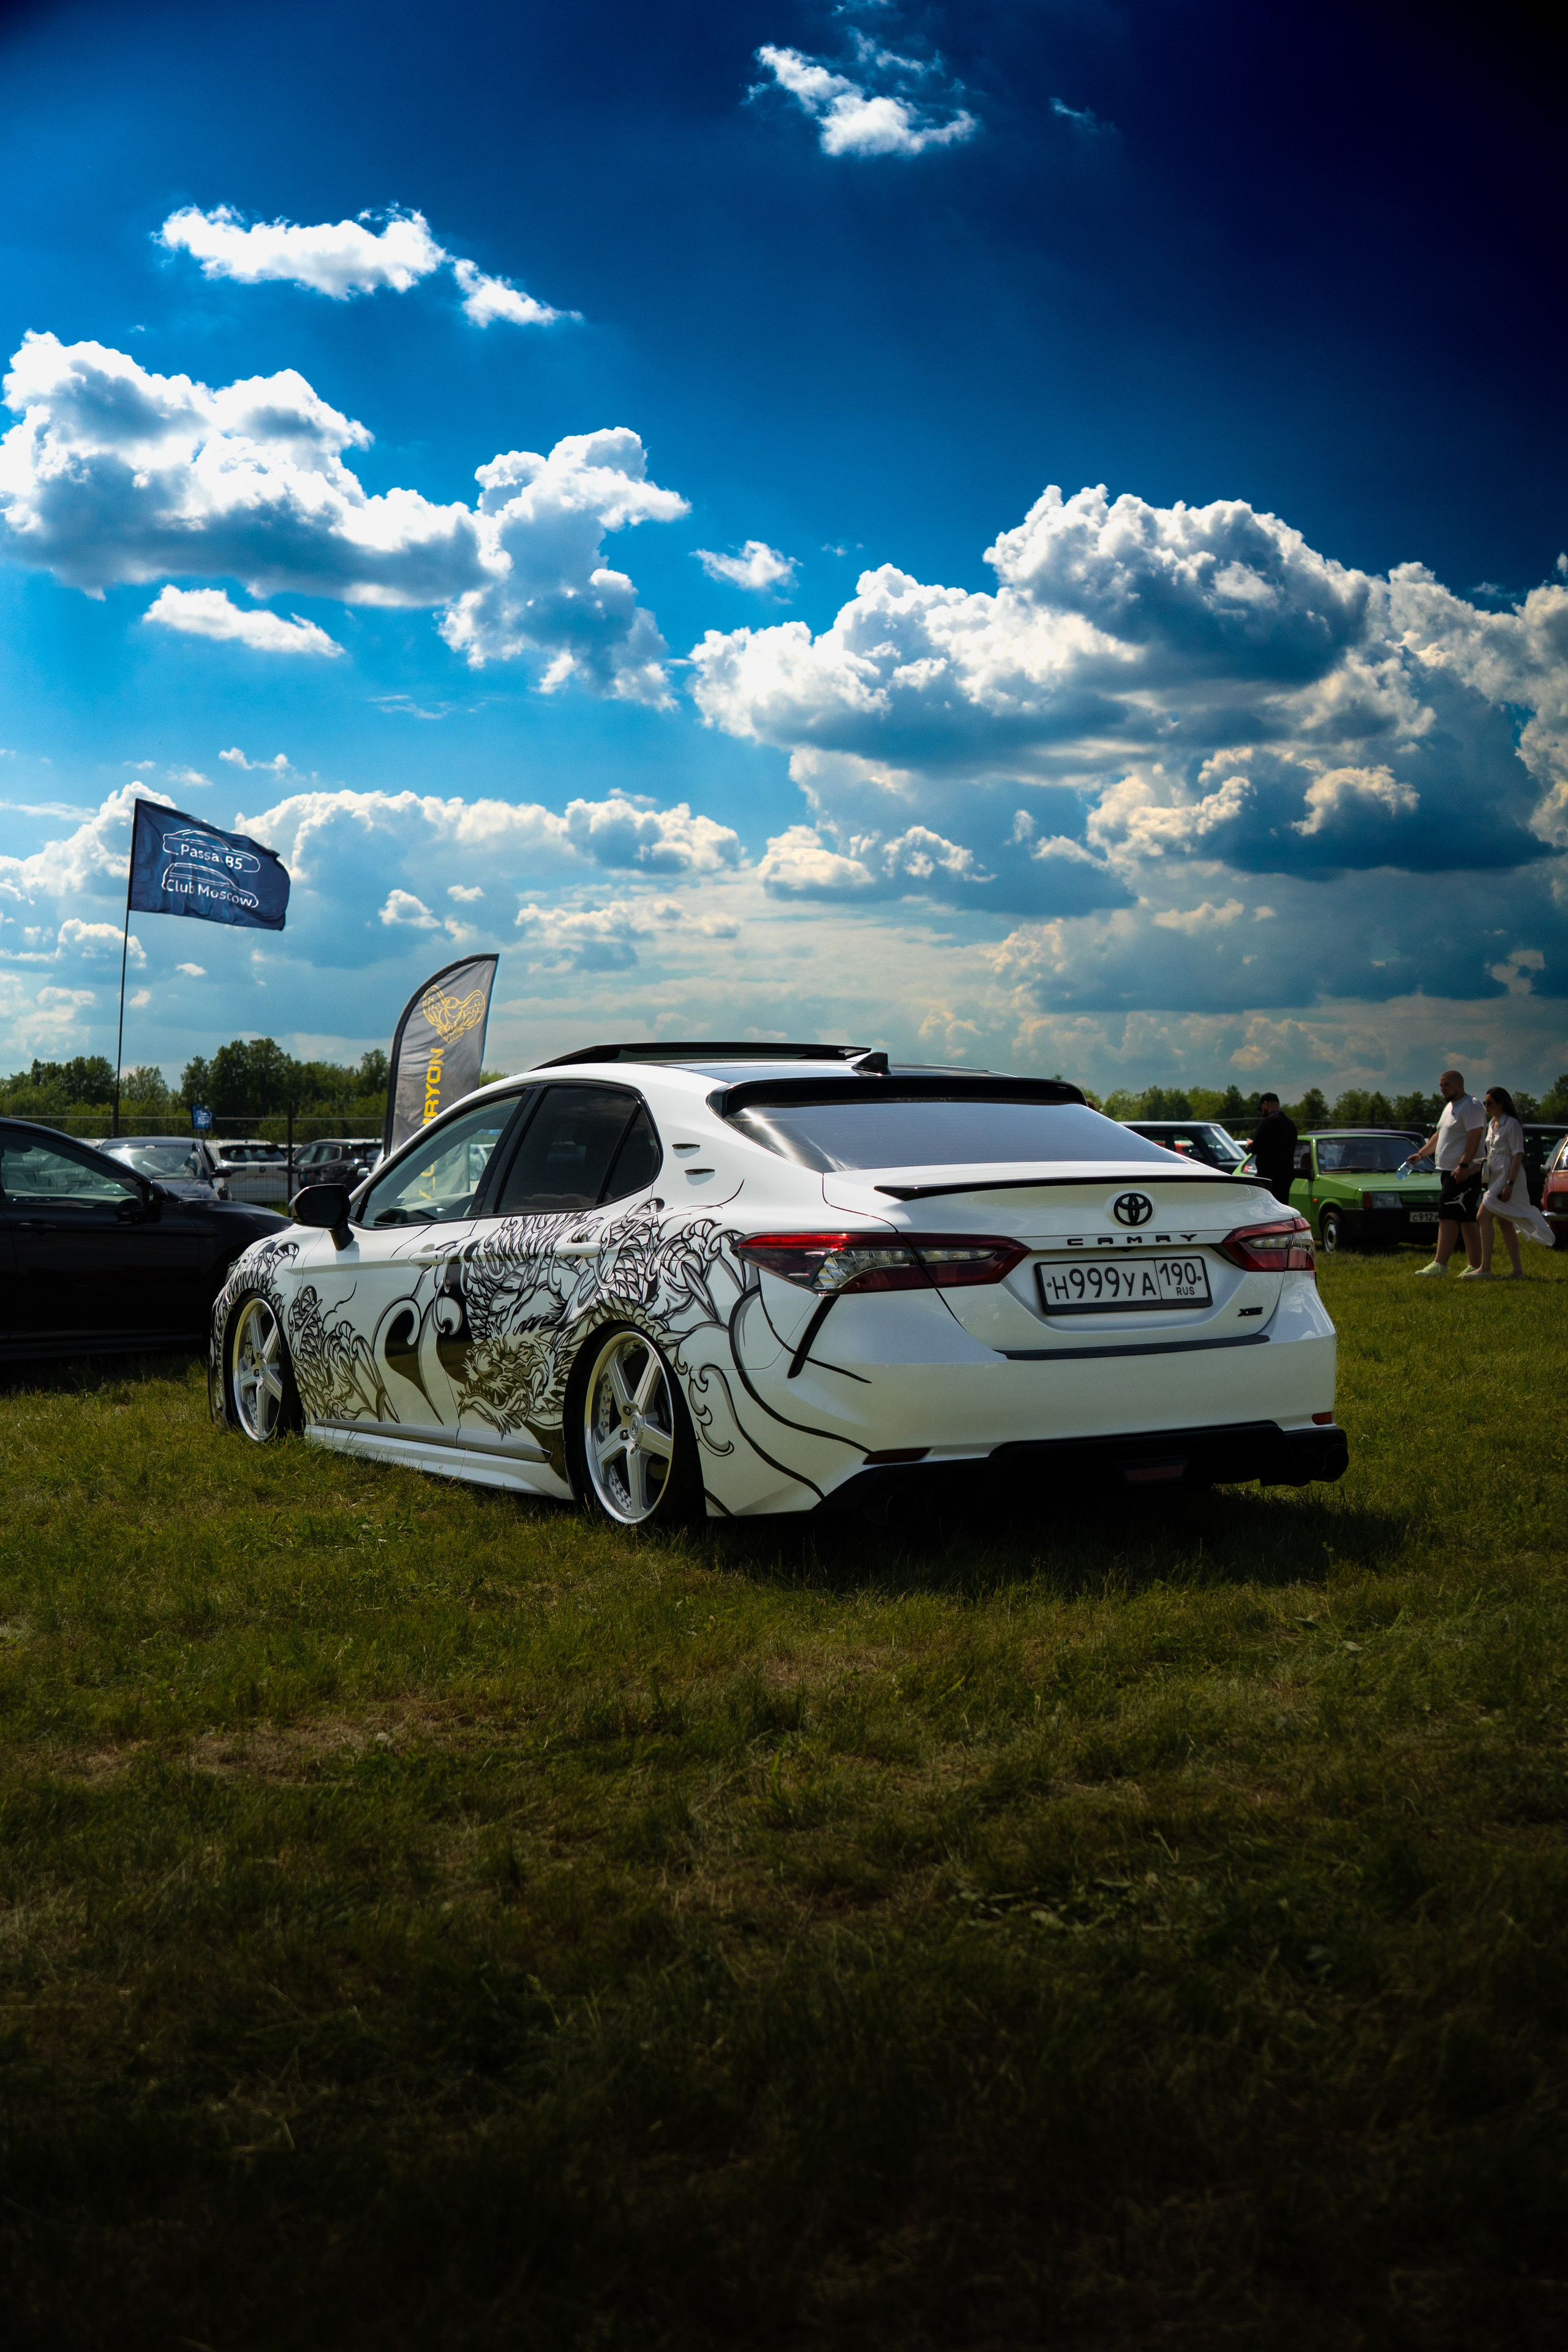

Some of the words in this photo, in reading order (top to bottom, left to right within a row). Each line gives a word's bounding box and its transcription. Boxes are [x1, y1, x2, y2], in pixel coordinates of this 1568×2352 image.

[225, 855, 243, 869] B5
[166, 880, 195, 894] Club
[198, 884, 253, 907] Moscow
[1067, 1234, 1198, 1246] CAMRY
[1052, 1267, 1157, 1300] Н999УА
[1159, 1262, 1197, 1286] 190
[1177, 1287, 1195, 1296] RUS
